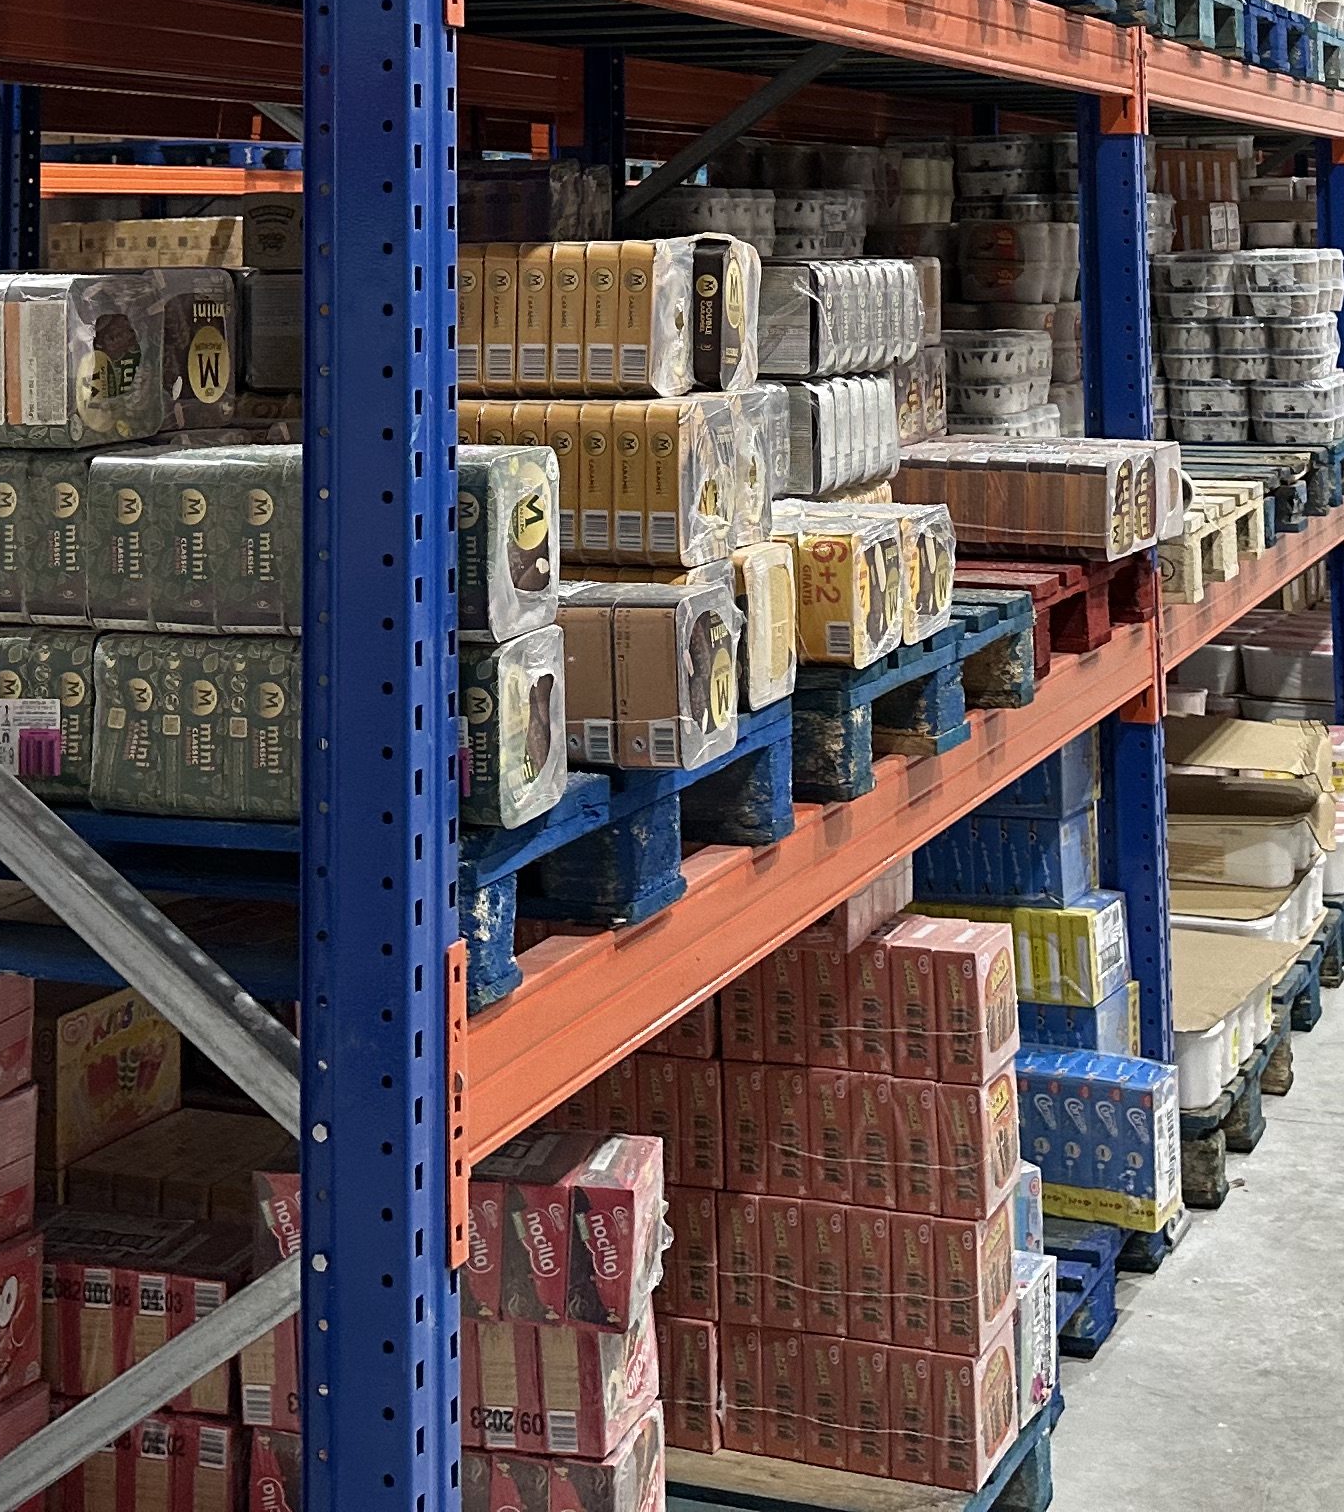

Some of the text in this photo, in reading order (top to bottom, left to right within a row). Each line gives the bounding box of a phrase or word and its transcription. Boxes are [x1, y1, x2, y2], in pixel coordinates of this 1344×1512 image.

[462, 276, 473, 286] M
[496, 275, 507, 286] M
[531, 275, 541, 286] M
[564, 275, 576, 285] M
[599, 275, 610, 285] M
[632, 275, 644, 285] M
[703, 280, 715, 291] M
[193, 303, 225, 323] mini
[198, 353, 220, 389] M
[558, 438, 570, 449] M
[591, 438, 603, 450] M
[624, 439, 636, 450] M
[658, 439, 670, 451] M
[0, 491, 12, 509] M
[59, 492, 76, 509] M
[123, 497, 140, 515] M
[187, 497, 203, 516] M
[253, 497, 270, 516] M
[461, 499, 476, 517] M
[4, 525, 17, 570] mini
[65, 525, 79, 572] mini
[129, 531, 143, 579] mini
[193, 532, 207, 580] mini
[259, 532, 274, 581] mini
[466, 536, 478, 586] mini
[812, 540, 848, 604] 6+2
[802, 564, 812, 606] GRATIS
[3, 677, 17, 694] M
[66, 681, 81, 697] M
[134, 688, 148, 704] M
[198, 690, 212, 707] M
[265, 690, 279, 709] M
[716, 676, 729, 715] M
[472, 696, 489, 716] M
[68, 714, 82, 761] mini
[136, 719, 150, 768] mini
[201, 723, 215, 771] mini
[267, 725, 282, 774] mini
[477, 731, 492, 781] mini
[526, 1212, 555, 1274] nocilla
[590, 1214, 618, 1276] nocilla
